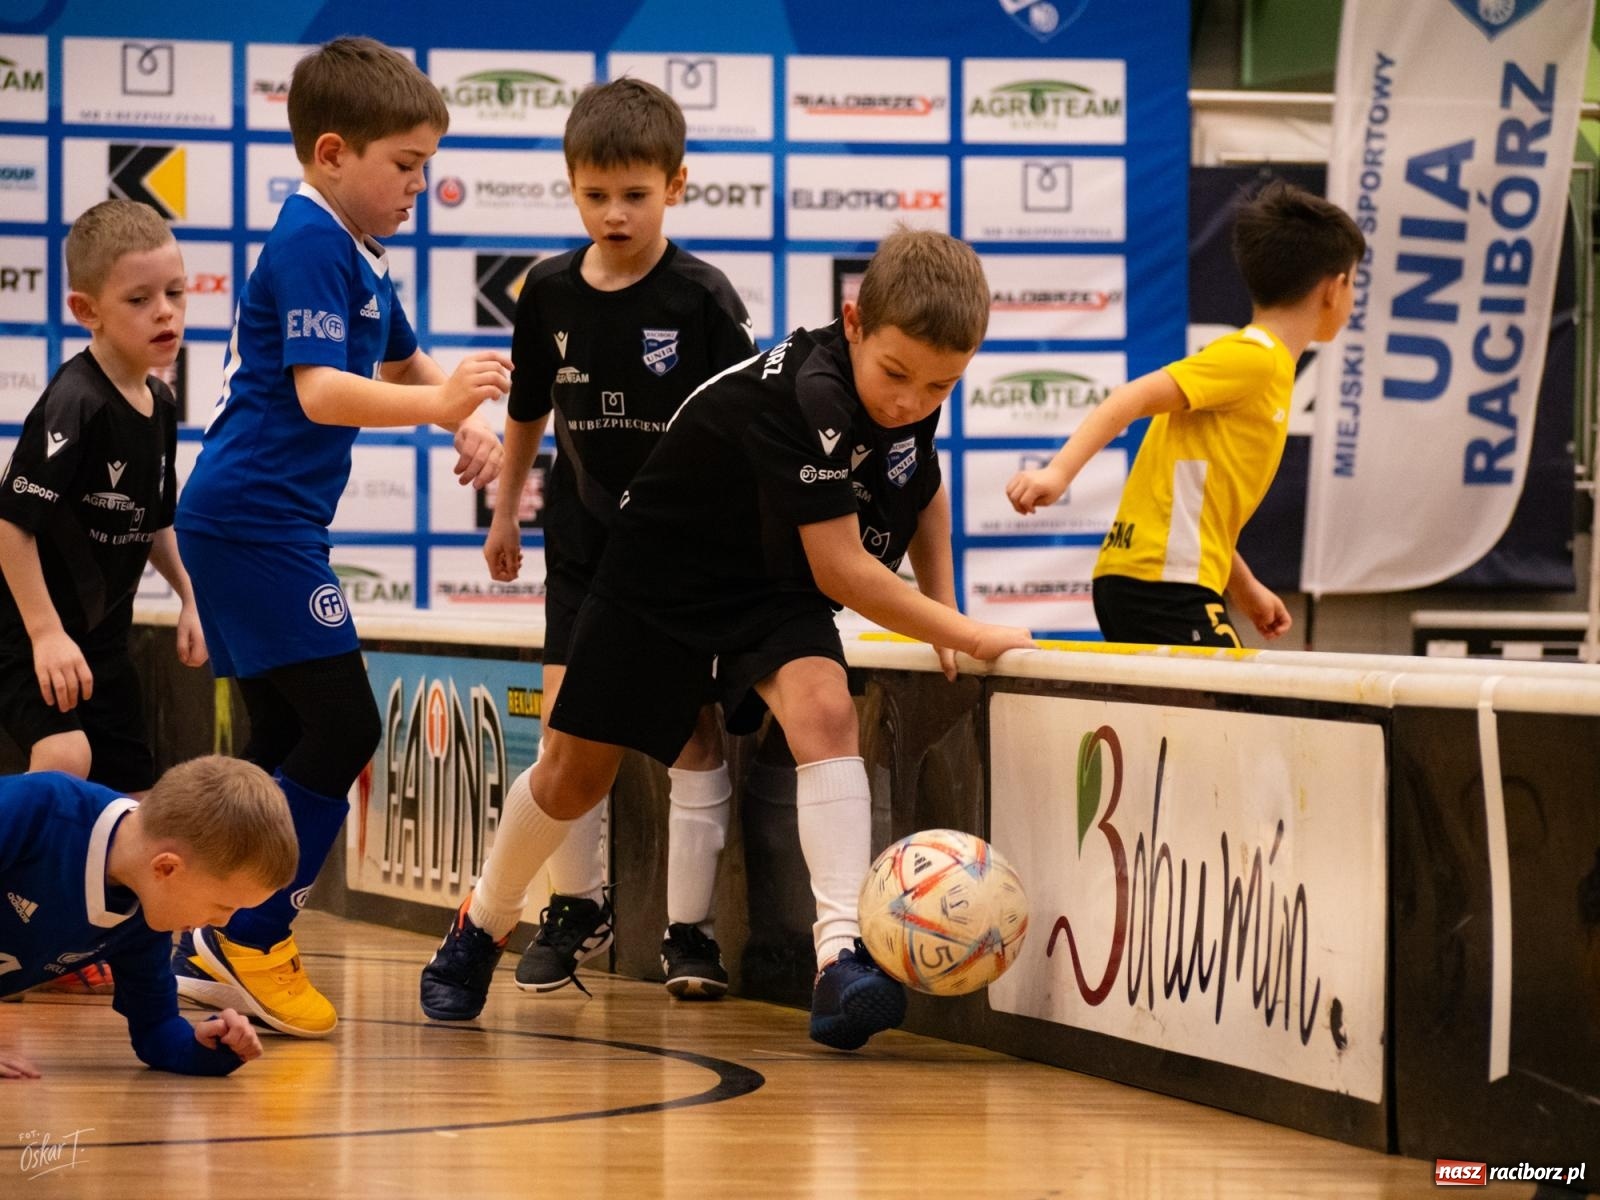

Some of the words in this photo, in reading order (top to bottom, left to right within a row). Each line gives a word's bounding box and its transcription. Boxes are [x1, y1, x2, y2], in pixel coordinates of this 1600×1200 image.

[0, 71, 44, 91] AM
[969, 96, 1121, 118] AGROTEAM
[0, 166, 36, 181] OUP
[792, 189, 945, 211] ELEKTROLEX
[1333, 344, 1365, 478] MIEJSKI
[1357, 52, 1396, 235] SPORTOWY
[1383, 138, 1476, 404] UNIA
[1462, 61, 1558, 487] RACIBÓRZ
[761, 340, 793, 381] ÓRZ
[26, 483, 60, 503] SPORT
